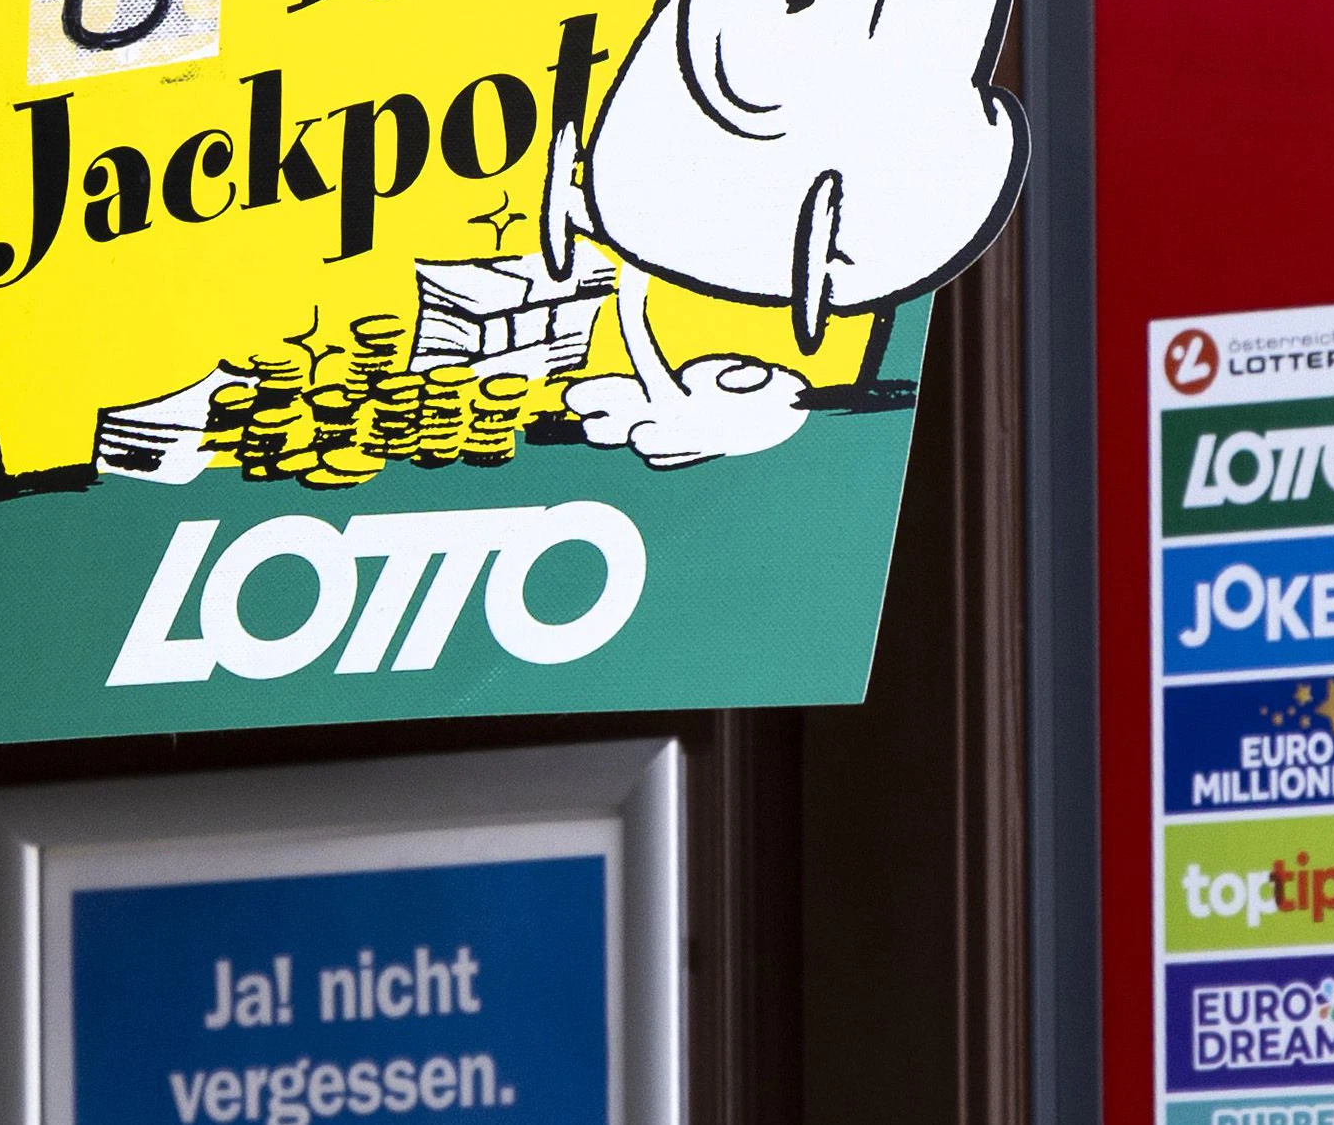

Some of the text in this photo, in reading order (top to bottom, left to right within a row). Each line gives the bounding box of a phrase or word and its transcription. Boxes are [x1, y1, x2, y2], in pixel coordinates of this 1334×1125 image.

[104, 499, 648, 687] LOTTO
[1240, 731, 1334, 769] EURO
[204, 945, 481, 1030] Ja! nicht
[1195, 985, 1315, 1029] EURO
[170, 1052, 516, 1125] vergessen.
